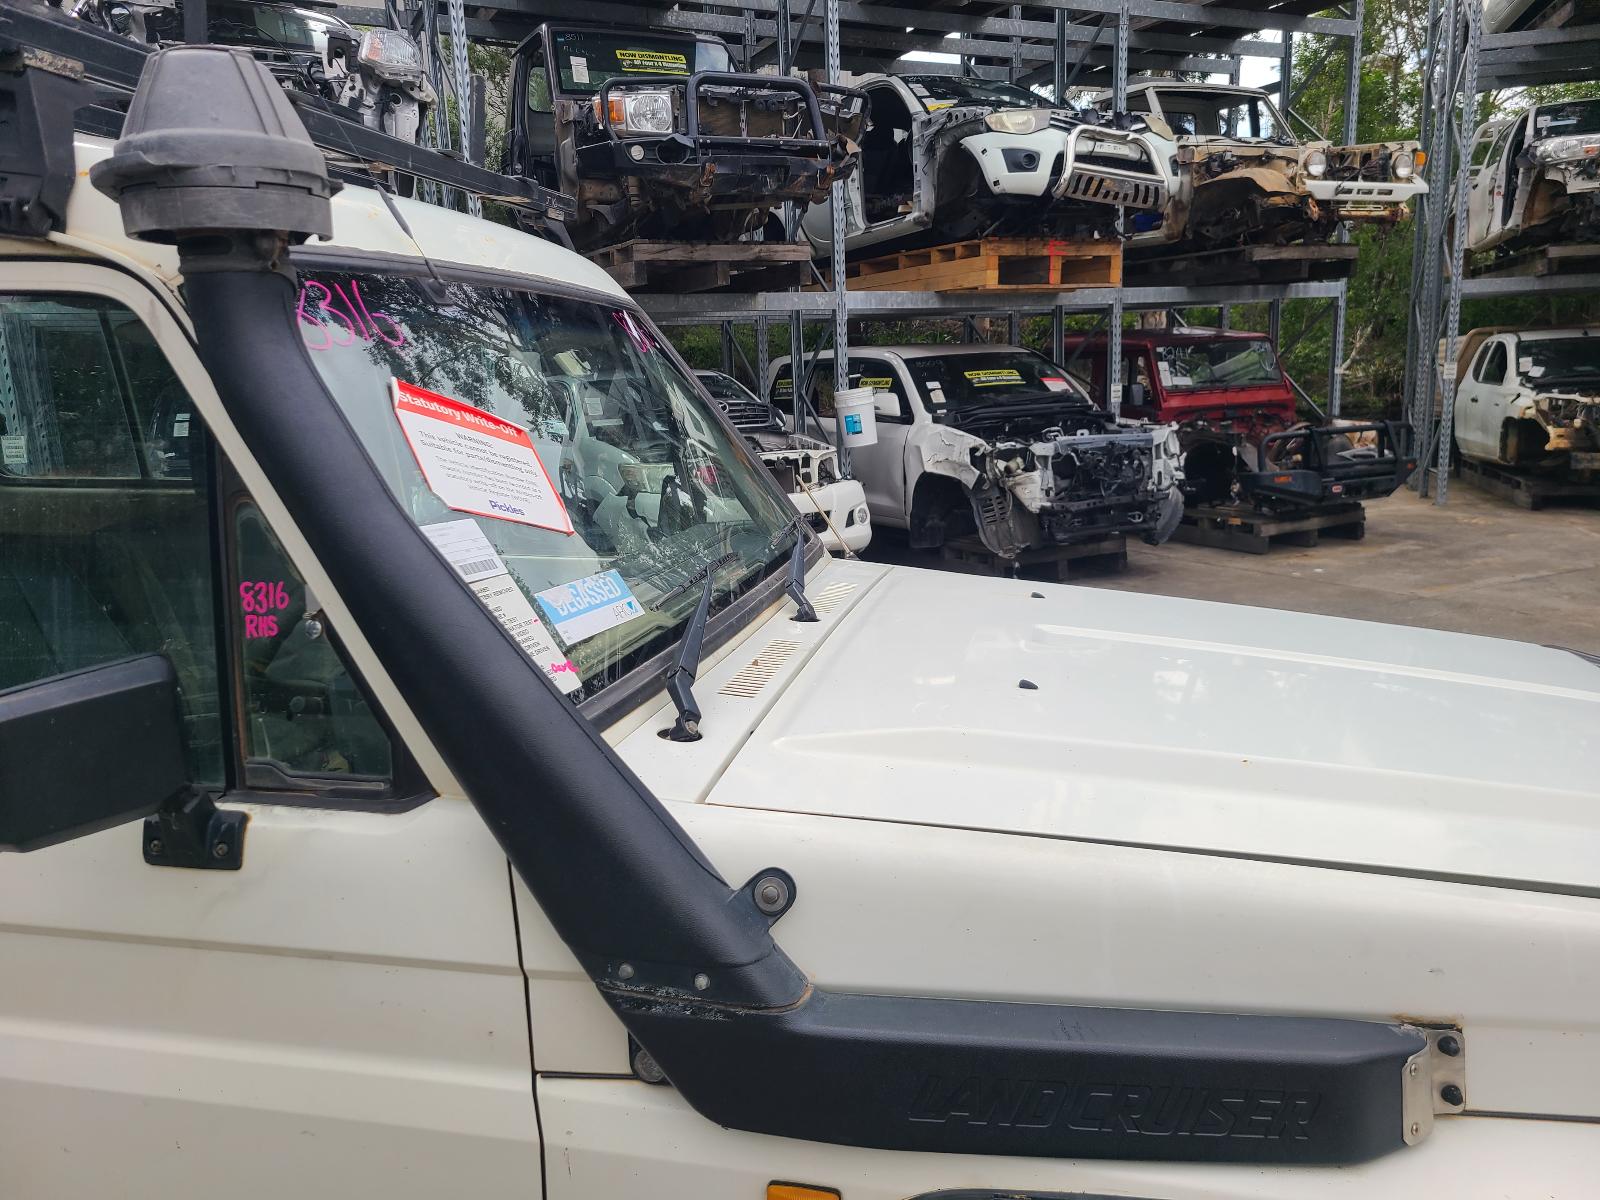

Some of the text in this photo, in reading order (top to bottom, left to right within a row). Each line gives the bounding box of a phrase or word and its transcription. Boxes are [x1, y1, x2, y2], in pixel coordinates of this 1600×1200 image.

[620, 51, 684, 62] NOW DISMANTLING
[400, 391, 518, 438] Statutory Write-Off
[488, 499, 525, 516] Pickles
[239, 580, 290, 614] 8316
[557, 575, 622, 617] DEGASSED
[245, 614, 279, 639] RHS
[907, 1074, 1321, 1140] LANDCRUISER
